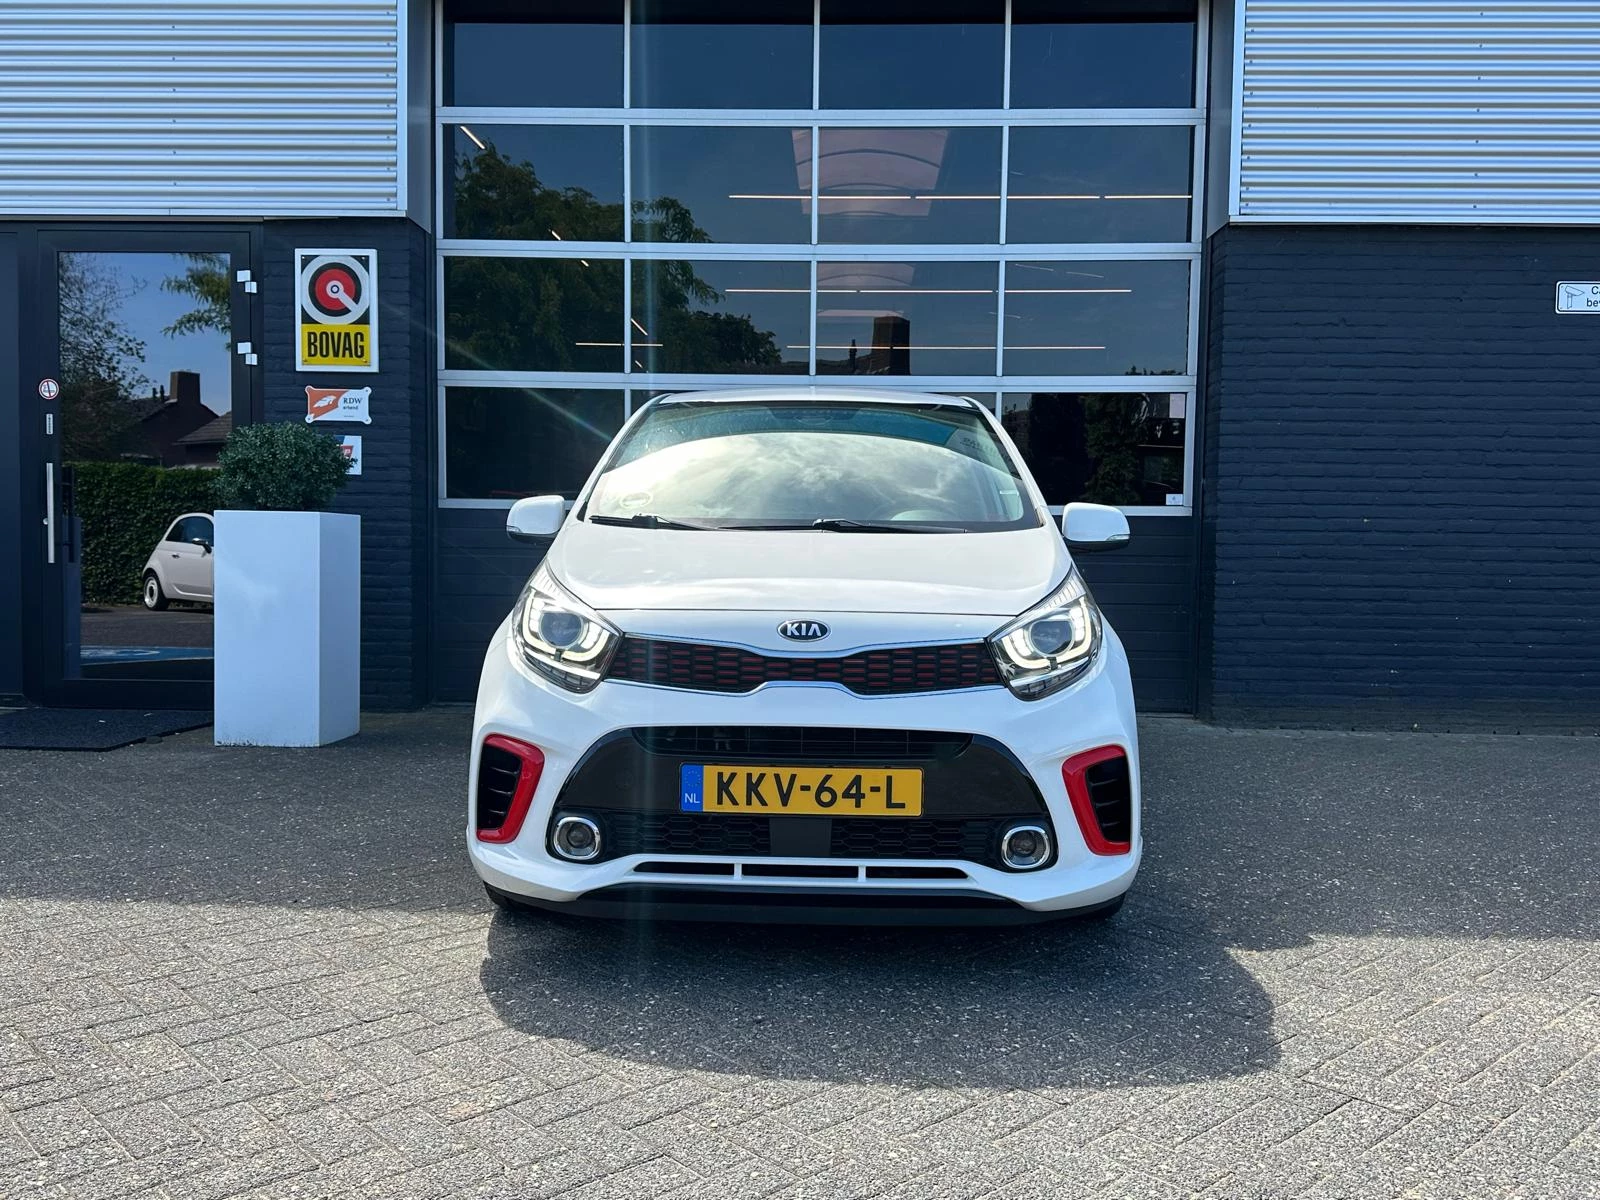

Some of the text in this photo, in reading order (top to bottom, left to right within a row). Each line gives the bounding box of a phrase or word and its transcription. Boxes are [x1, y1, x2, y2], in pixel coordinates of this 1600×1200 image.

[1591, 285, 1600, 295] C
[1586, 297, 1600, 307] be
[307, 331, 365, 359] BOVAG
[343, 397, 361, 405] RDW
[786, 622, 822, 637] KIA
[716, 771, 906, 809] KKV-64-L
[684, 792, 701, 804] NL
